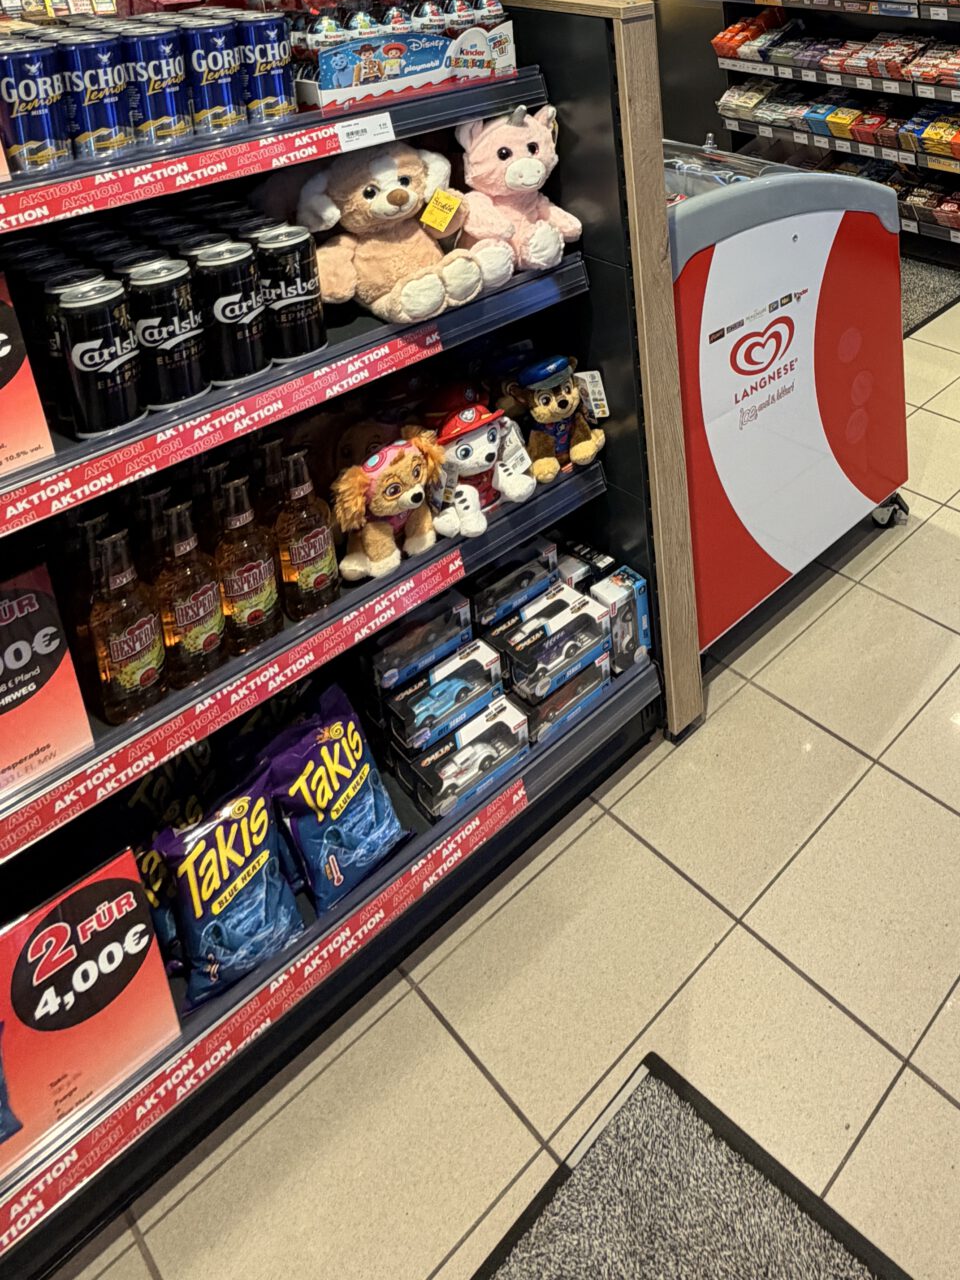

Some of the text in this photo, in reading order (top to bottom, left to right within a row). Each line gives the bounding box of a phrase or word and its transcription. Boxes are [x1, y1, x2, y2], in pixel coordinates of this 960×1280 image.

[404, 59, 440, 74] playmobil
[10, 93, 63, 119] Lemon
[82, 81, 128, 107] Lemon
[134, 161, 189, 187] AKTION
[175, 162, 228, 187] AKTION
[272, 145, 318, 168] AKTION
[0, 205, 50, 230] KTION
[214, 292, 264, 324] Carls
[136, 310, 202, 348] Carlsb
[71, 330, 138, 372] Carlsb
[347, 346, 390, 374] AKTION
[325, 370, 369, 400] AKTION
[734, 360, 796, 405] LANGNESE
[193, 406, 246, 441] AKTION
[233, 401, 284, 433] AKTION
[6, 478, 72, 519] AKTION
[51, 473, 114, 513] AKTION
[290, 532, 332, 566] DESPERA
[0, 593, 40, 626] ÜR
[175, 592, 219, 628] DESPERA
[373, 578, 416, 614] AKTION
[110, 616, 161, 663] DESPERA
[353, 607, 396, 644] AKTION
[15, 666, 41, 687] Pfand
[229, 662, 280, 705] AKTION
[266, 651, 315, 691] AKTION
[0, 683, 37, 706] HRWEG
[0, 744, 52, 776] esperados
[95, 752, 155, 802] AKTION
[52, 762, 117, 814] AKTION
[441, 817, 481, 859] AKTION
[217, 859, 263, 910] BLUE HEAT
[421, 850, 463, 892] AKTION
[27, 891, 137, 988] 2 FÜR
[303, 926, 351, 978] AKTION
[339, 910, 385, 959] AKTION
[34, 923, 150, 1021] 4,00€
[175, 1039, 232, 1100] AKTION
[135, 1058, 195, 1121] AKTION
[9, 1149, 79, 1220] AKTION
